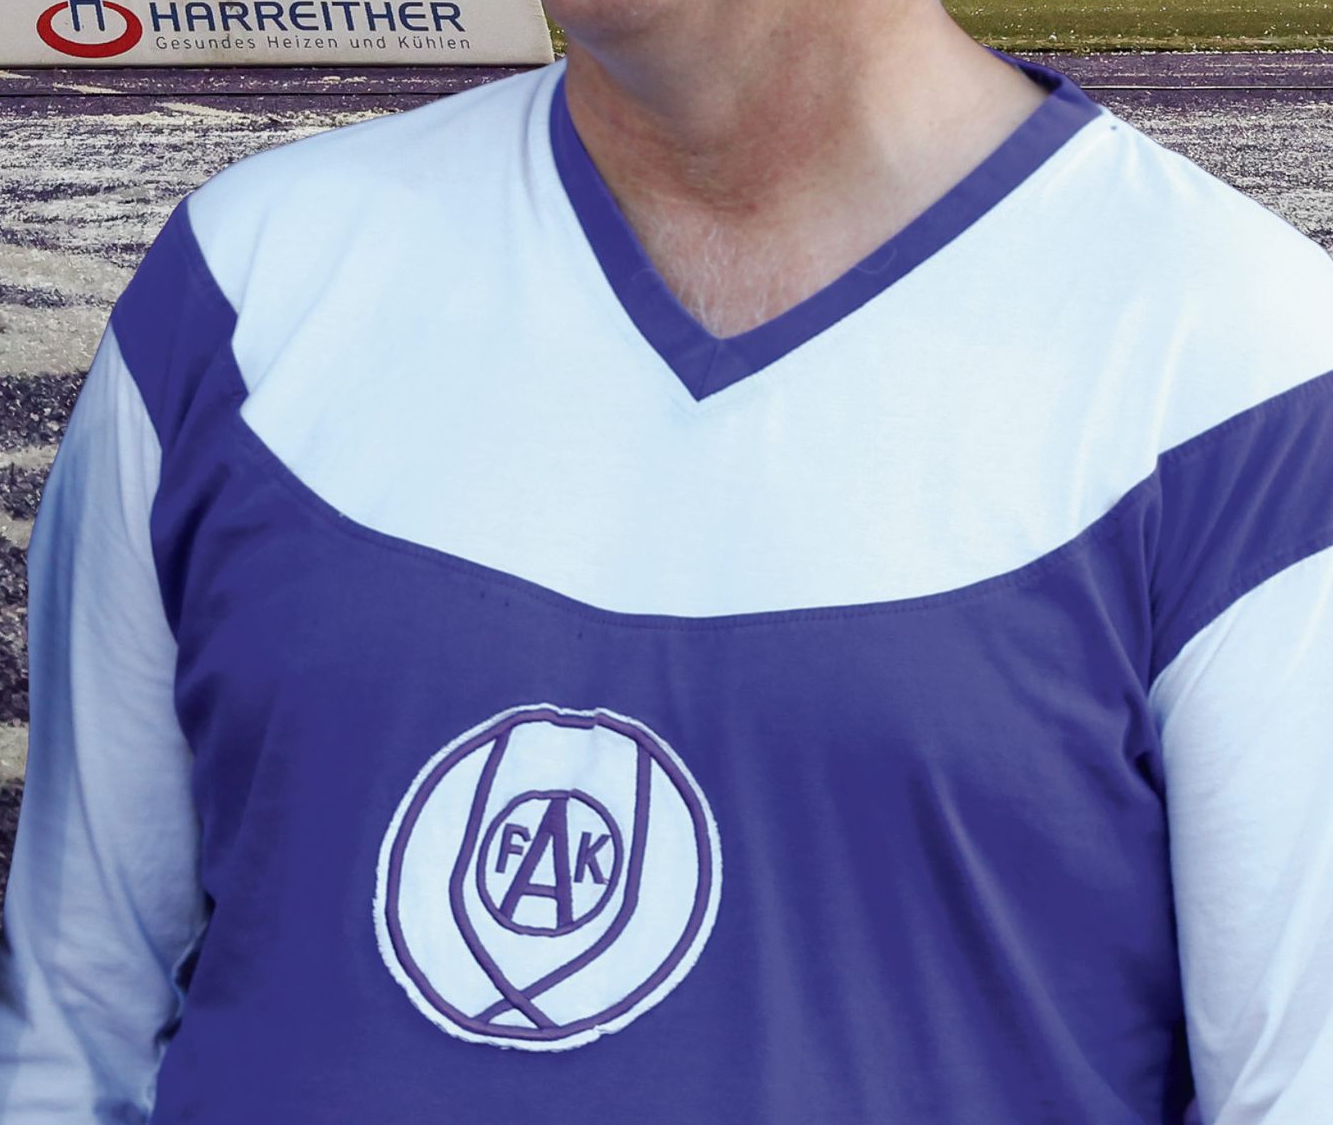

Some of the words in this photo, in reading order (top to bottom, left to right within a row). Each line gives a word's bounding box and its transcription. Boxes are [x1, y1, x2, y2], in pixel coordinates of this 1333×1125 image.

[149, 0, 466, 32] HARREITHER
[156, 34, 256, 49] Gesundes
[267, 34, 338, 49] Heizen
[350, 35, 386, 49] und
[398, 34, 470, 49] Kühlen
